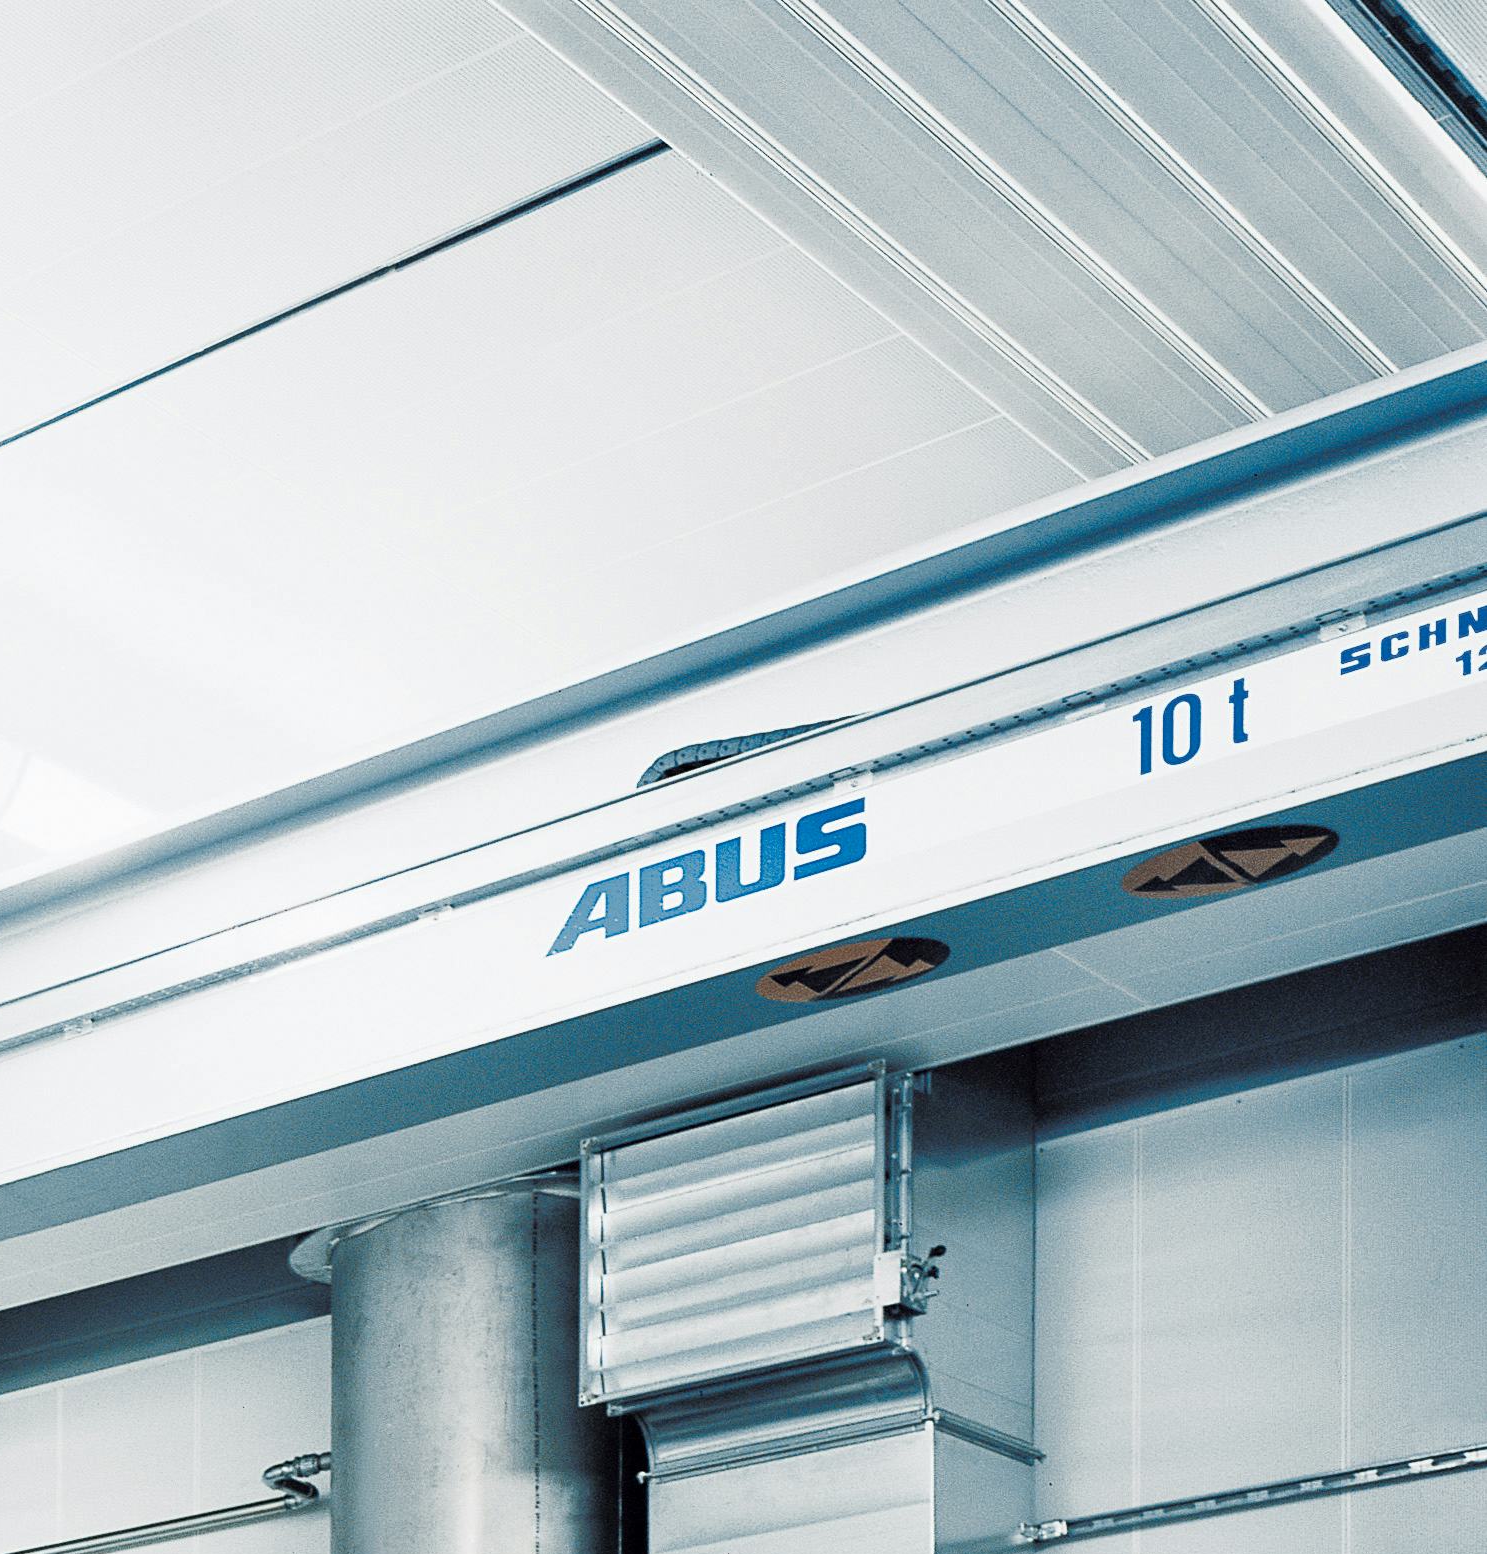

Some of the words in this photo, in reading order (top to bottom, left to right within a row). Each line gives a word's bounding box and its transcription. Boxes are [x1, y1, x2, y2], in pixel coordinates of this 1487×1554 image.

[1340, 605, 1487, 675] SCHN
[1132, 693, 1201, 775] 10
[1228, 677, 1249, 744] t
[545, 797, 867, 957] ABUS
